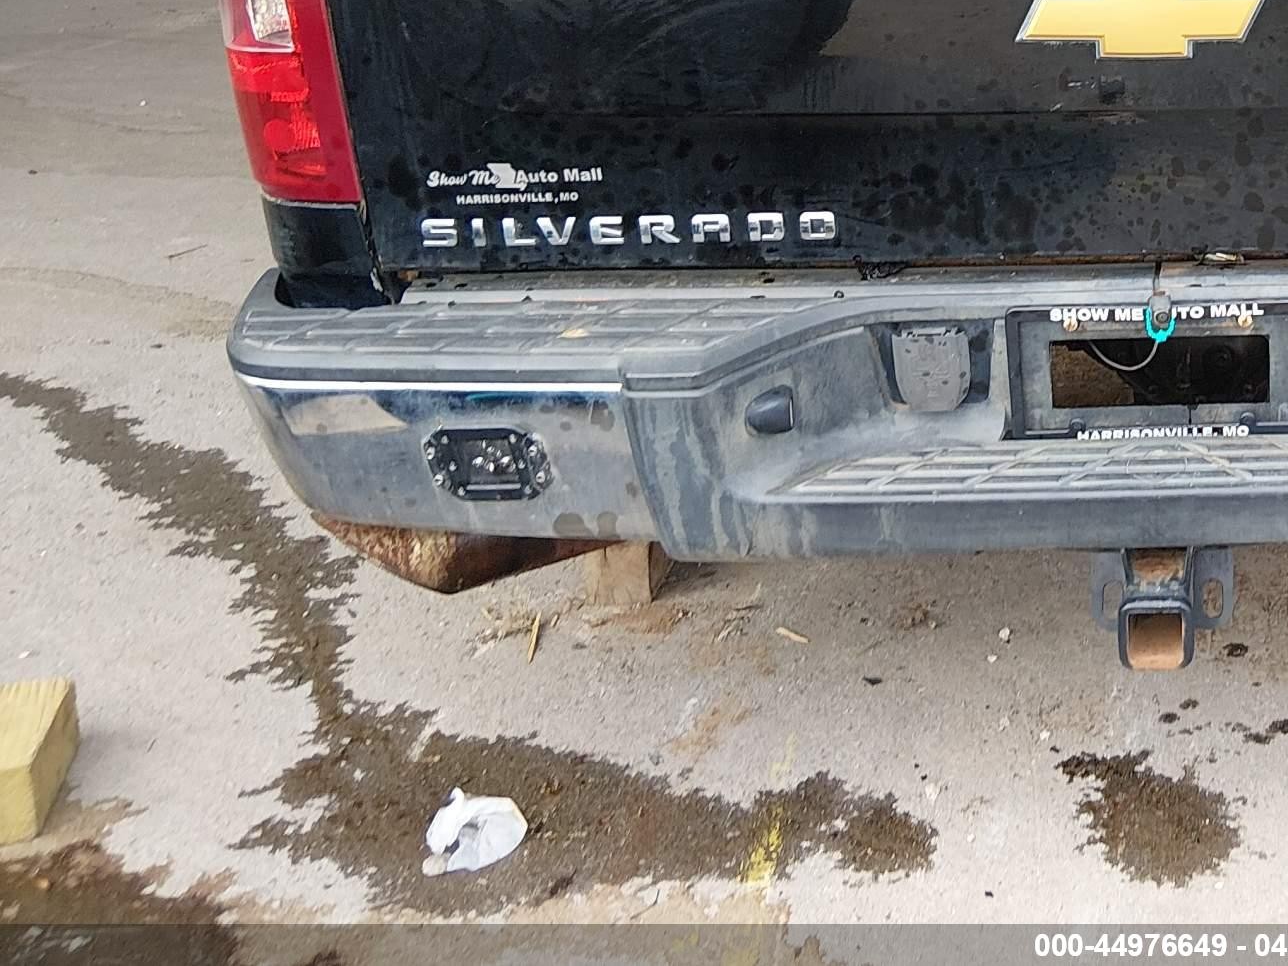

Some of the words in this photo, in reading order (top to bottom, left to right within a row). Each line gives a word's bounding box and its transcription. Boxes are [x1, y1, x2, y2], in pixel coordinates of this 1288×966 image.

[427, 170, 467, 187] Show
[468, 170, 500, 185] Me
[515, 169, 559, 184] Auto
[563, 167, 603, 182] Mall
[420, 211, 837, 247] SILVERADO
[1050, 307, 1109, 322] SHOW
[1114, 307, 1144, 321] ME
[1210, 303, 1265, 318] MALL
[1223, 425, 1250, 437] MO
